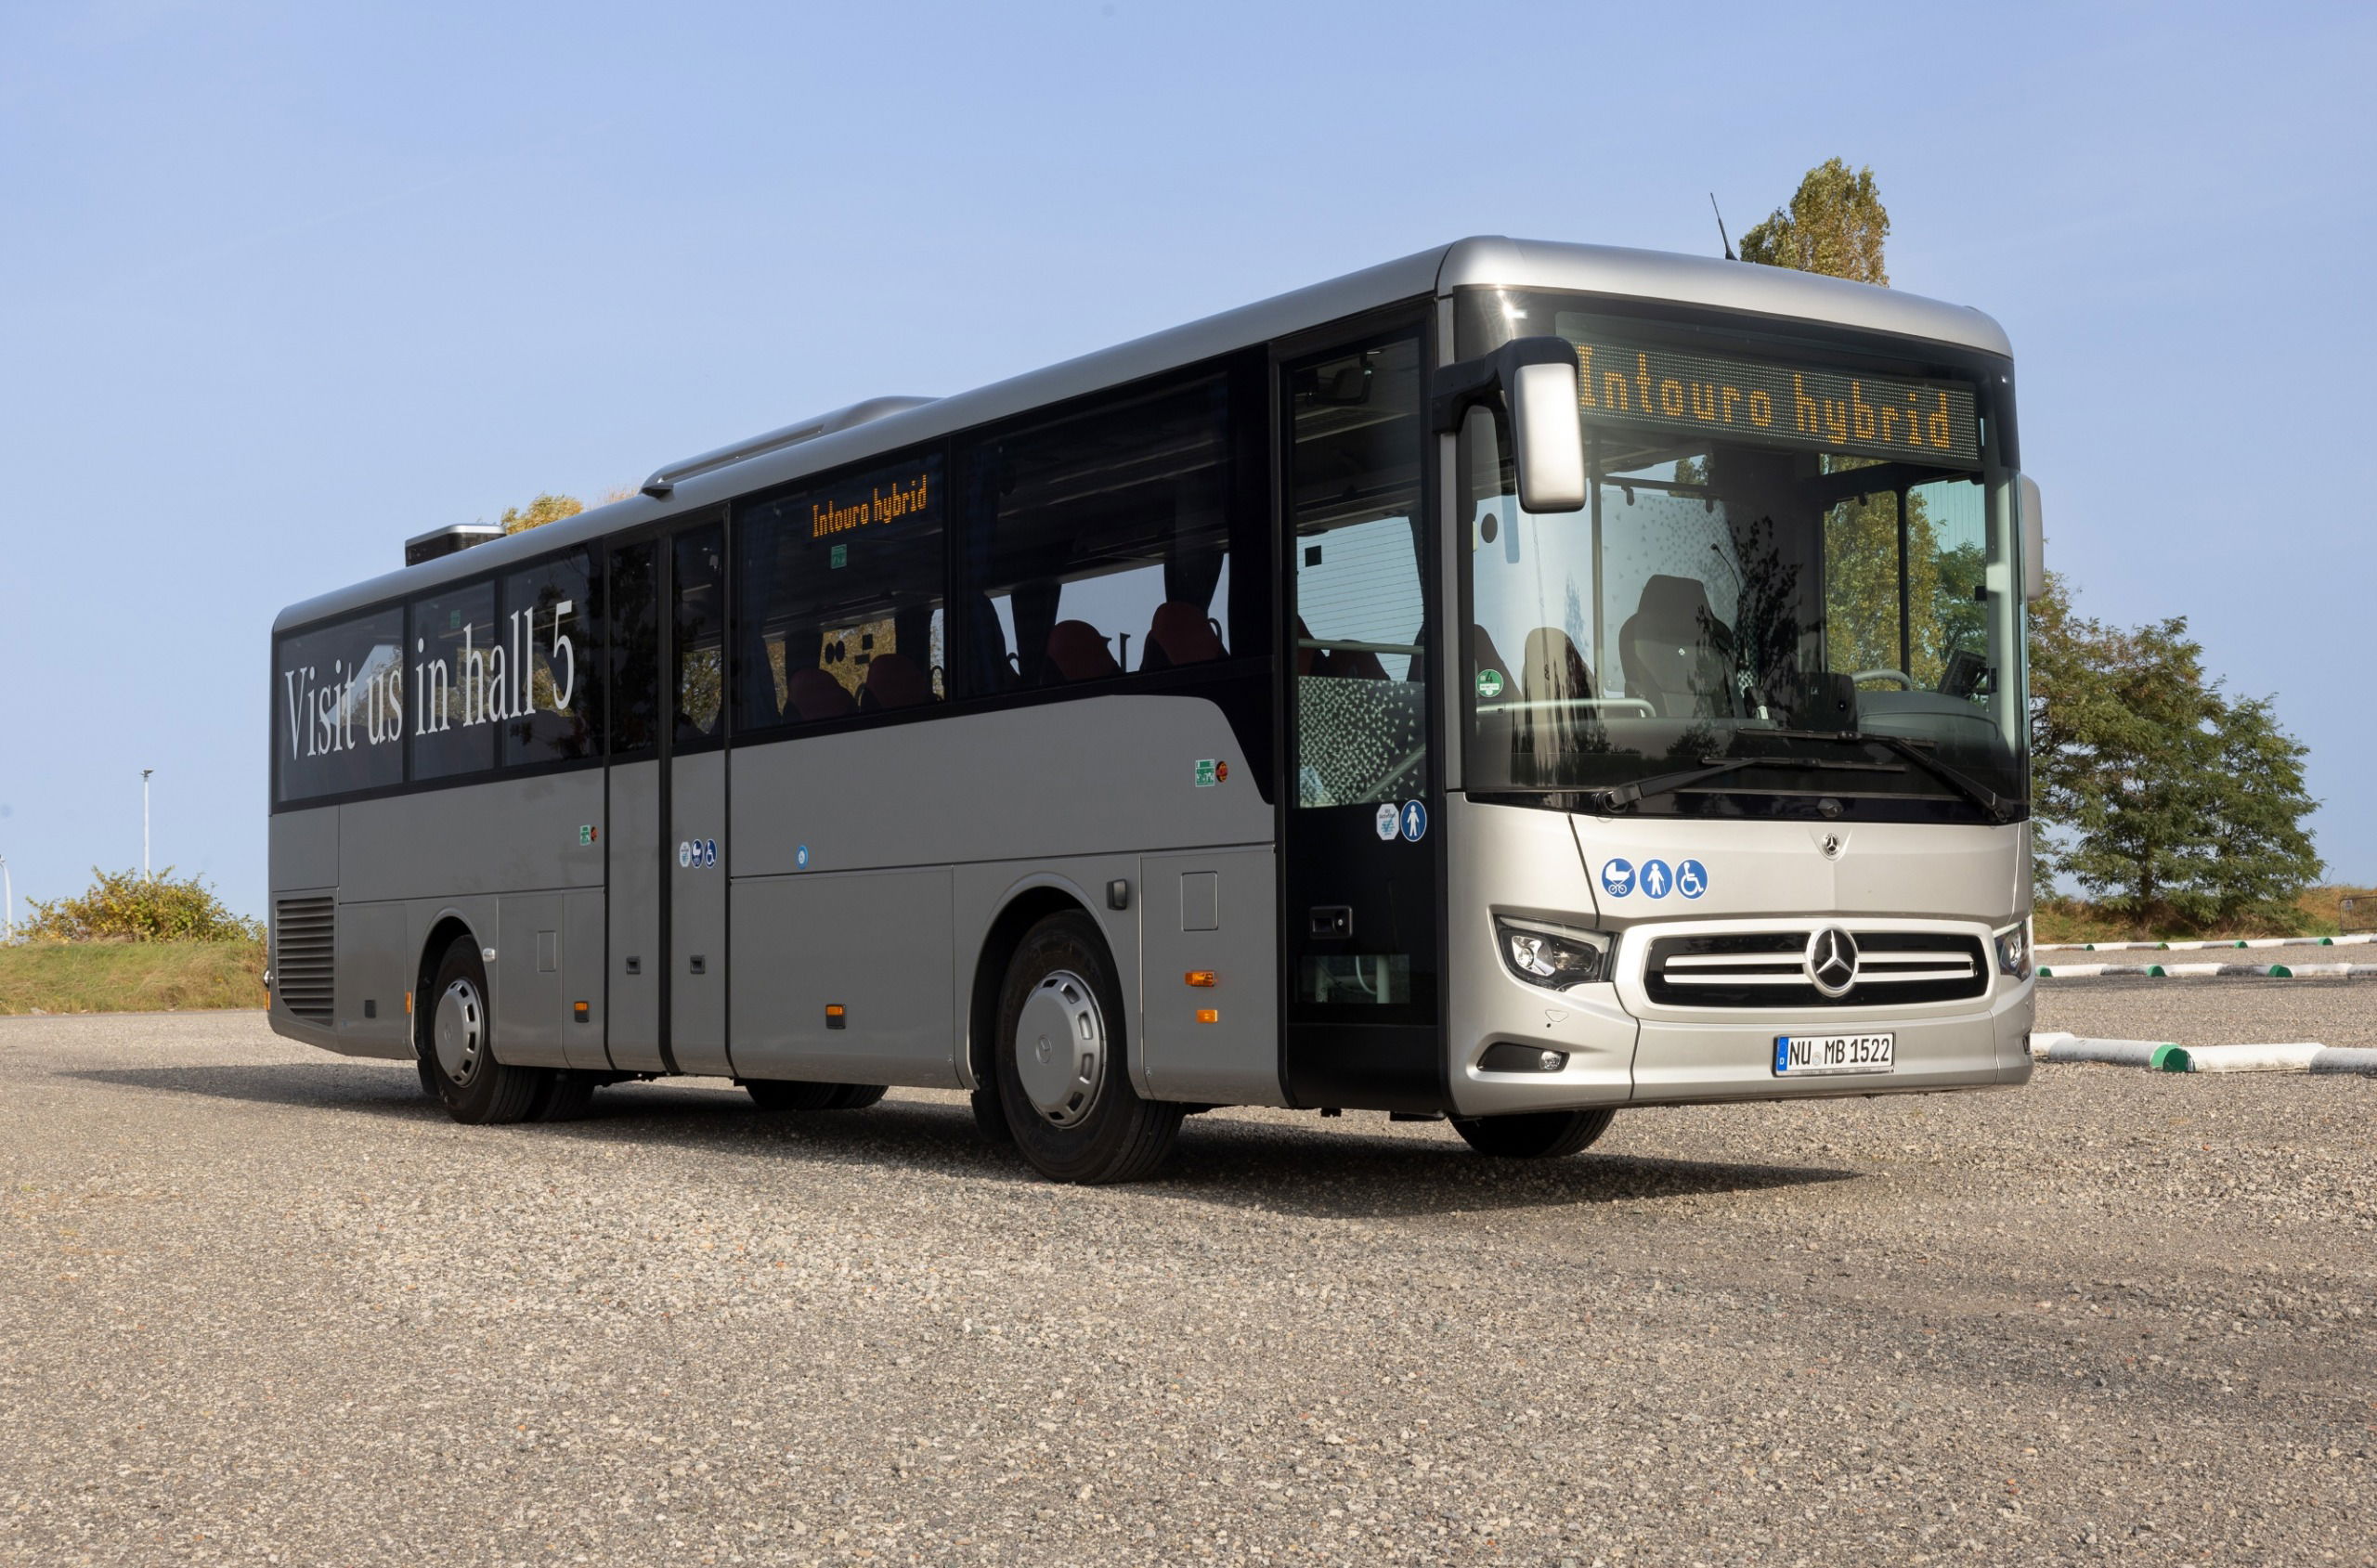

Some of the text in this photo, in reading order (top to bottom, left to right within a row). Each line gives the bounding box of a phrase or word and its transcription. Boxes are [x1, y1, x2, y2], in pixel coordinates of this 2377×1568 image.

[1578, 345, 1950, 449] Intouro hybrid
[812, 474, 927, 538] Intouro hybrid
[285, 600, 575, 761] Visit us in hall 5
[1486, 671, 1493, 684] 4
[1779, 1038, 1890, 1066] D NU MB 1522
